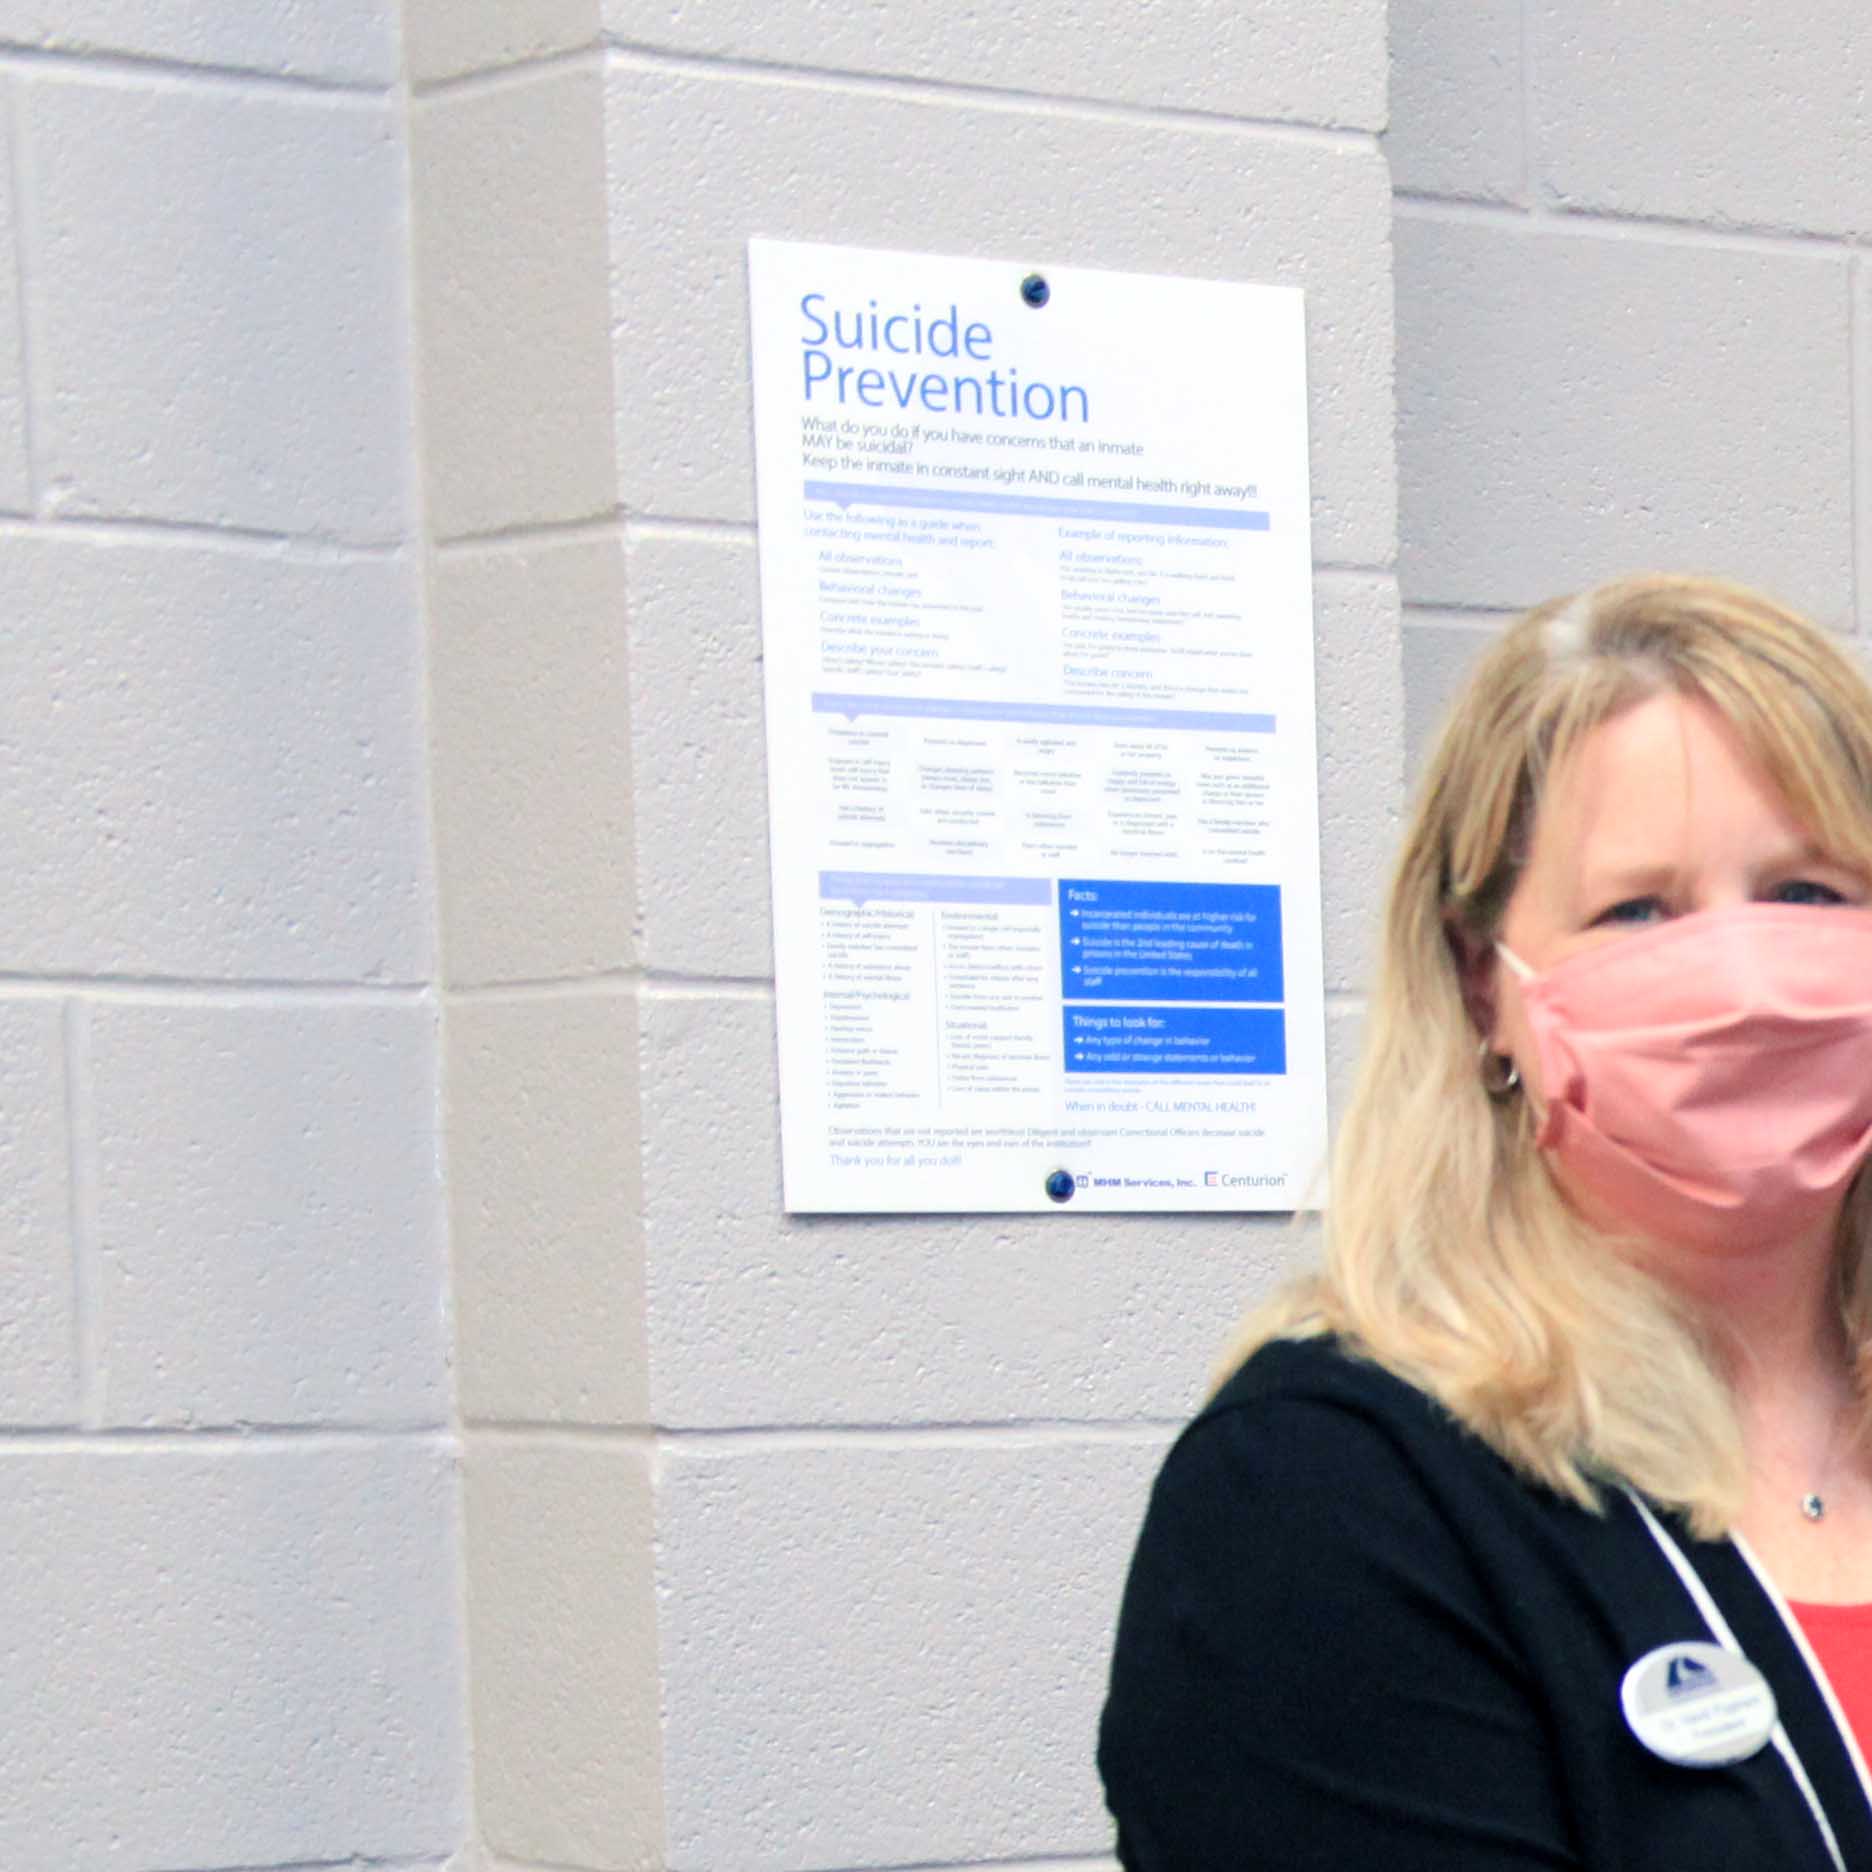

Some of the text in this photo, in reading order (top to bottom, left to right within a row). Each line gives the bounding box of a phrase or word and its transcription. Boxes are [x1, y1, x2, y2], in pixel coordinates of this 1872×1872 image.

[801, 294, 993, 360] Suicide
[803, 350, 1090, 423] Prevention
[802, 416, 1144, 456] What do you do if you have concerns that an inmate
[802, 434, 832, 449] MAY
[836, 438, 853, 450] be
[802, 453, 838, 471] Keep
[840, 457, 863, 470] the
[867, 459, 913, 474] inmate
[916, 463, 929, 476] in
[932, 464, 990, 480] constant
[993, 468, 1026, 485] sight
[1028, 469, 1060, 484] AND
[1062, 472, 1084, 487] call
[1087, 474, 1133, 490] mental
[1136, 476, 1177, 493] health
[1180, 479, 1211, 497] right
[1072, 1015, 1107, 1030] Things
[1110, 1017, 1121, 1028] to
[1123, 1016, 1145, 1028] look
[1065, 1101, 1096, 1112] When
[1097, 1101, 1106, 1112] in
[1108, 1101, 1137, 1113] doubt
[1146, 1101, 1171, 1112] CALL
[1173, 1101, 1213, 1112] MENTAL
[1176, 1178, 1197, 1188] Inc.
